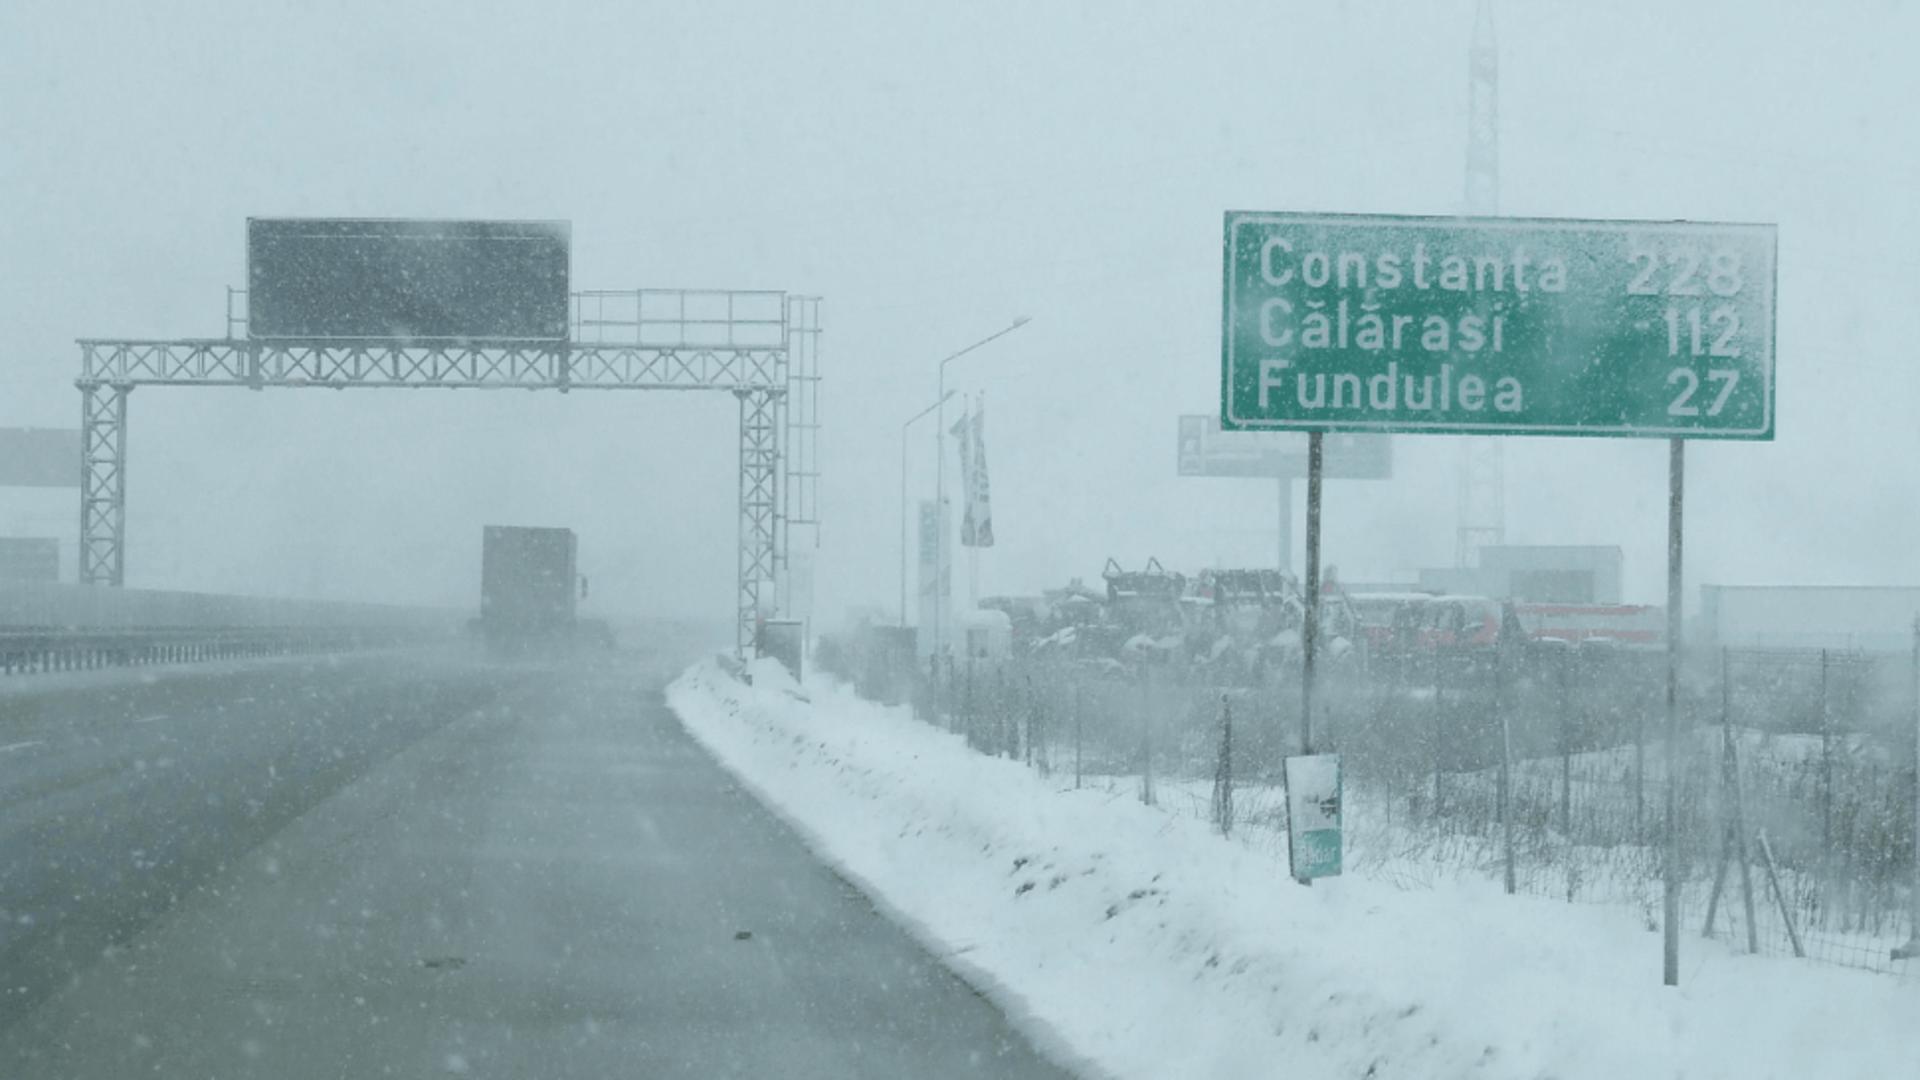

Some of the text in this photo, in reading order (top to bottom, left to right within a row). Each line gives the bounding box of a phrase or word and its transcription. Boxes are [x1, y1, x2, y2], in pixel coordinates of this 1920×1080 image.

[1627, 248, 1742, 297] 228
[1663, 305, 1741, 357] 112
[1258, 359, 1740, 416] Fundulea 27
